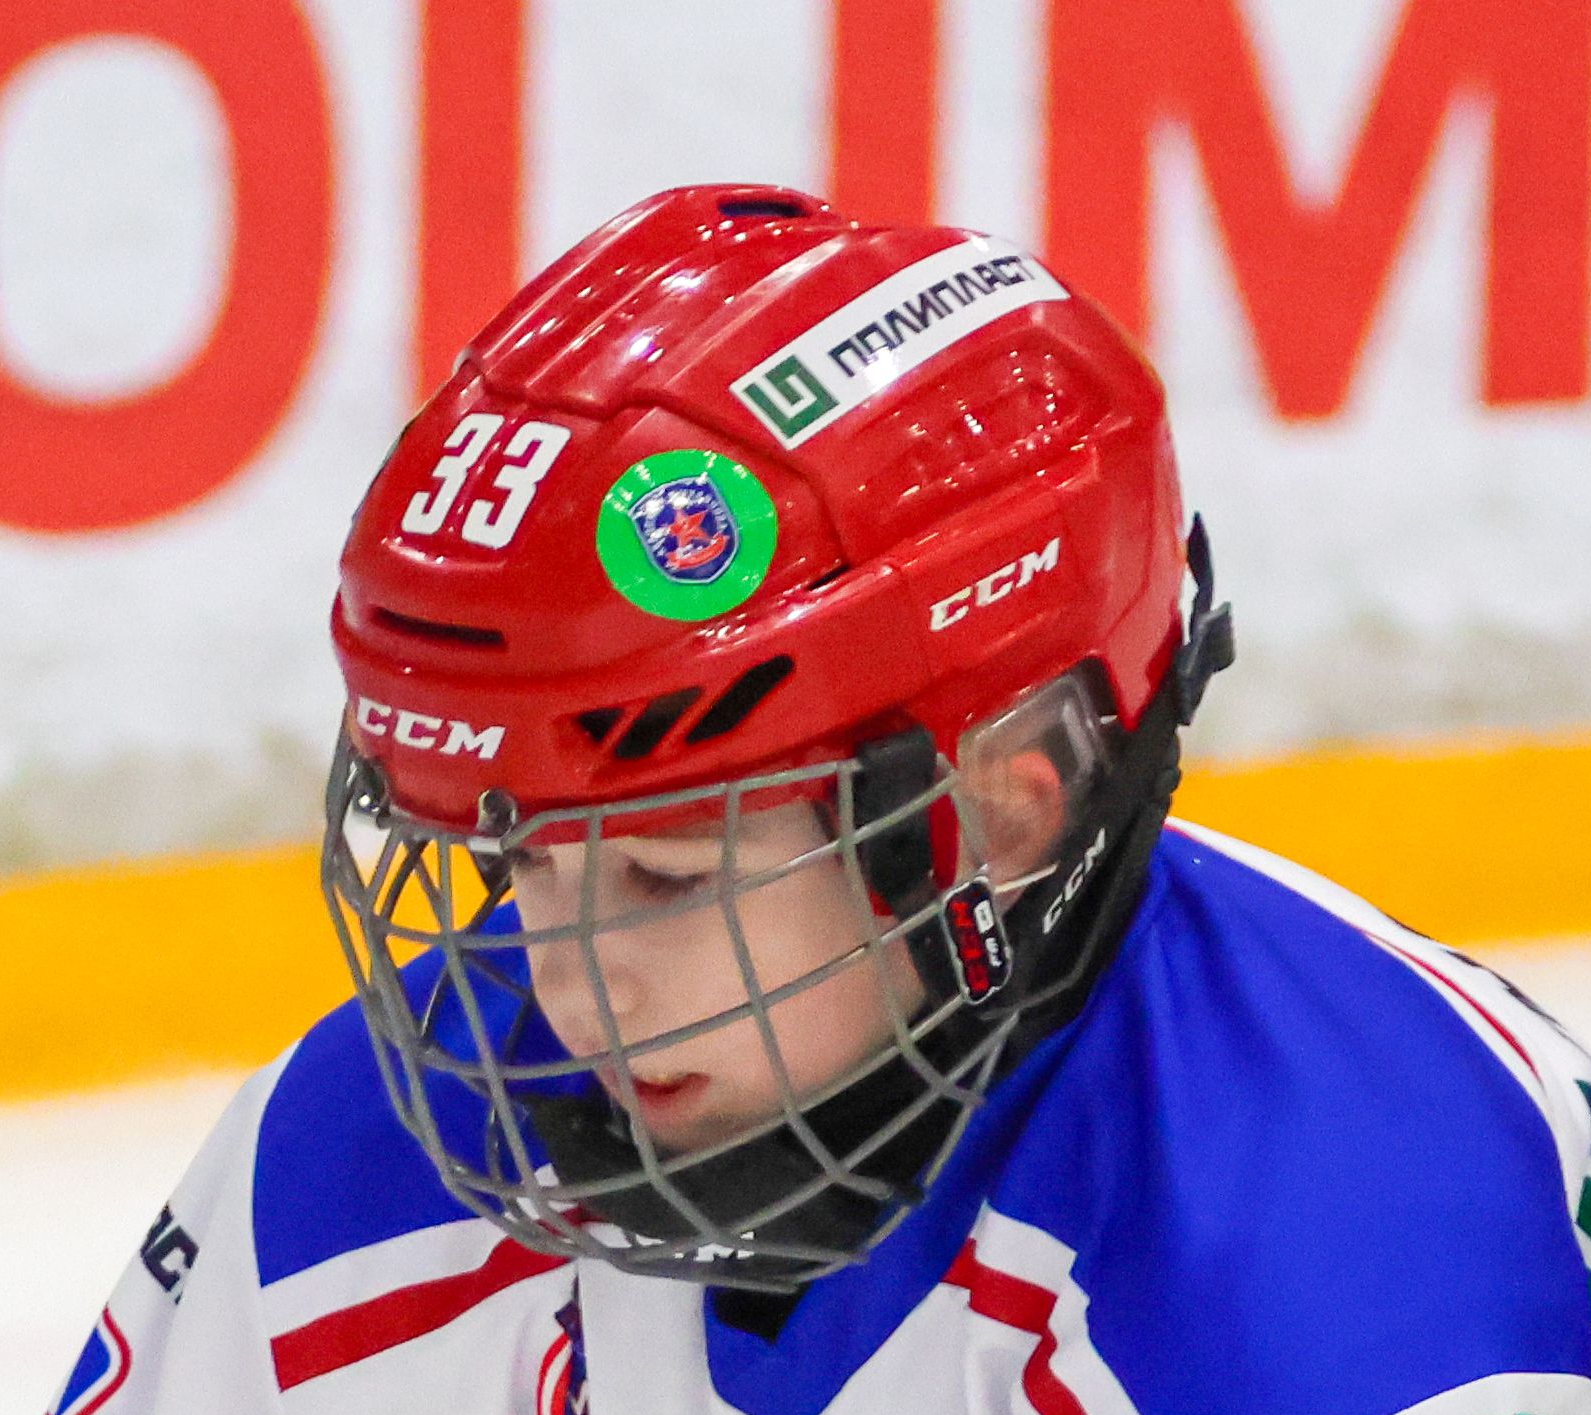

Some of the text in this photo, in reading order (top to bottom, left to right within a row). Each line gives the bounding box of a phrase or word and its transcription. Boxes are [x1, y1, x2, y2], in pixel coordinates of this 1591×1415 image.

[400, 412, 572, 550] 33
[929, 536, 1061, 632] CCM
[357, 695, 506, 760] CCM
[1042, 827, 1106, 935] CCM
